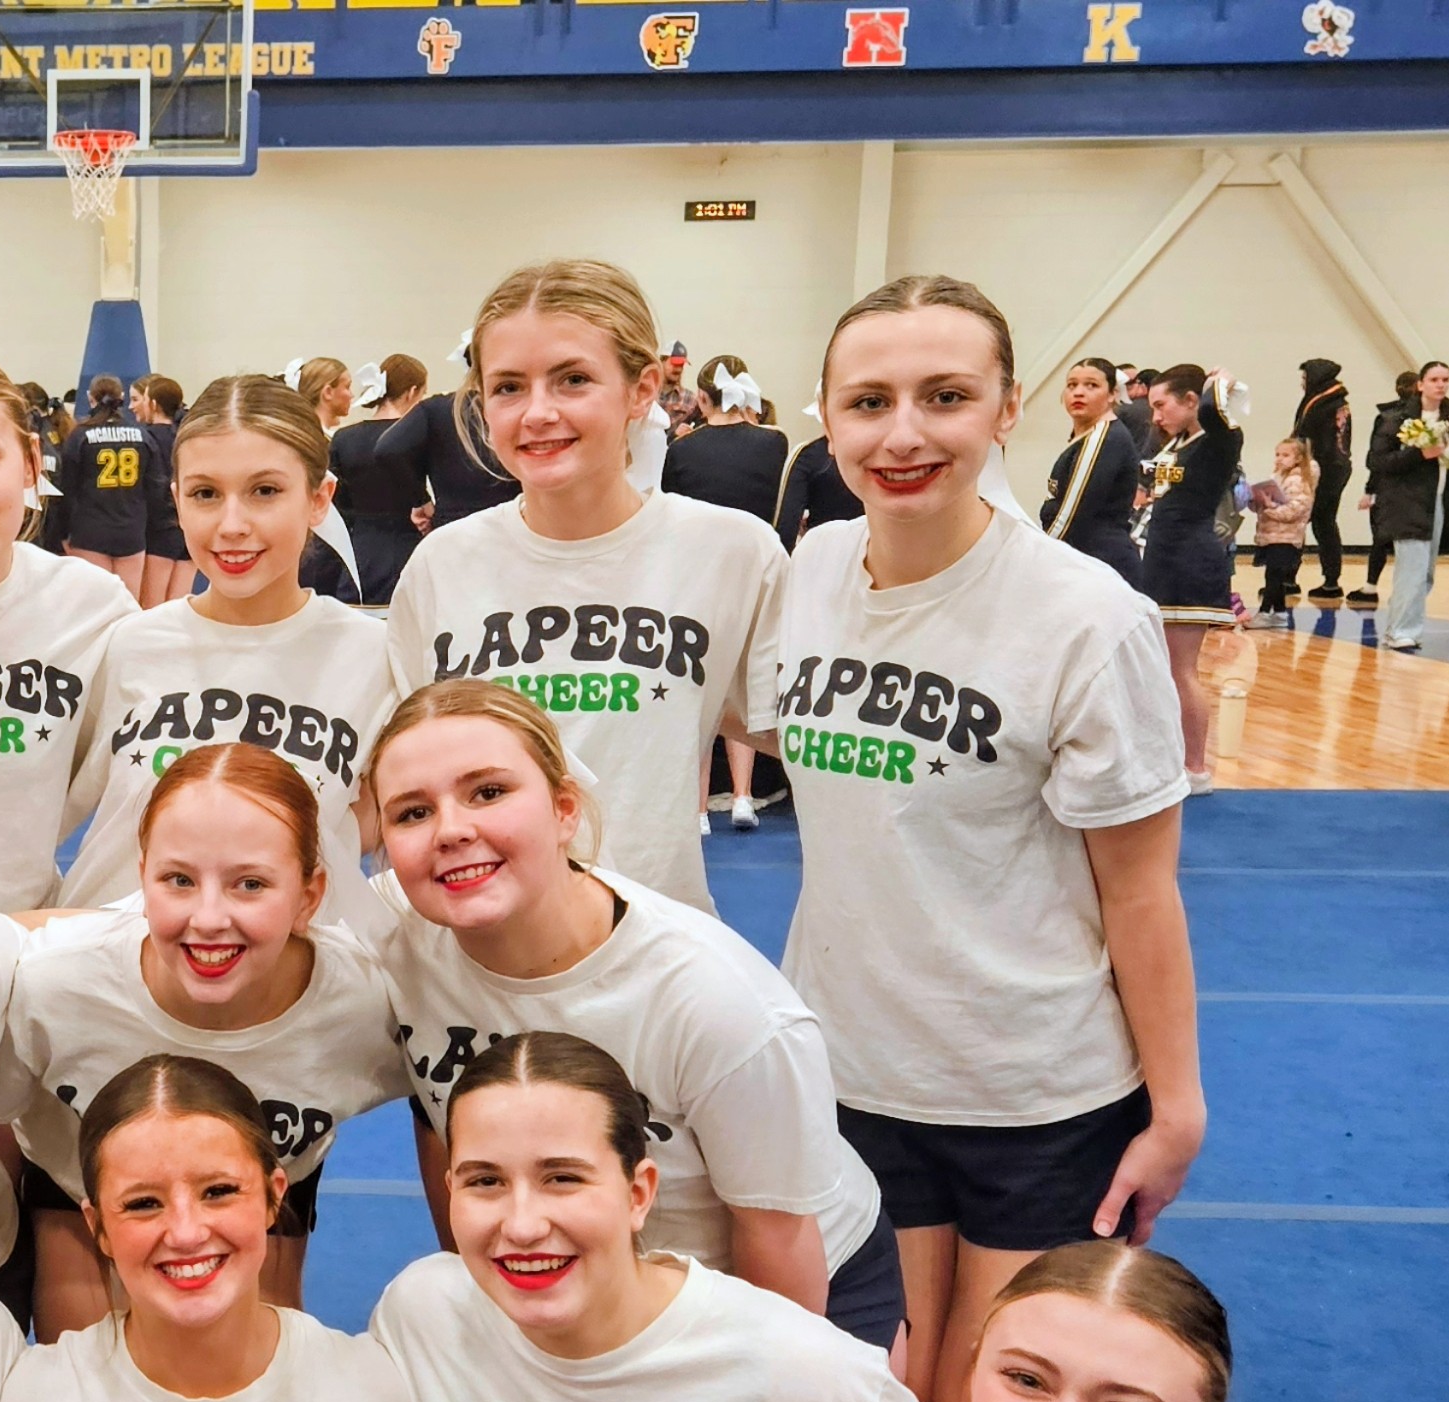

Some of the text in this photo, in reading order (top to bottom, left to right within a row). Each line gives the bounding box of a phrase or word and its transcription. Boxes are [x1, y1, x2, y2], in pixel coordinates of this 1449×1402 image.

[1083, 2, 1142, 63] K
[54, 43, 171, 77] METRO
[727, 203, 747, 216] PM
[85, 426, 143, 443] MCALLISTER
[96, 447, 139, 488] 28
[434, 603, 710, 687] LAPEER
[784, 724, 917, 784] CHEER
